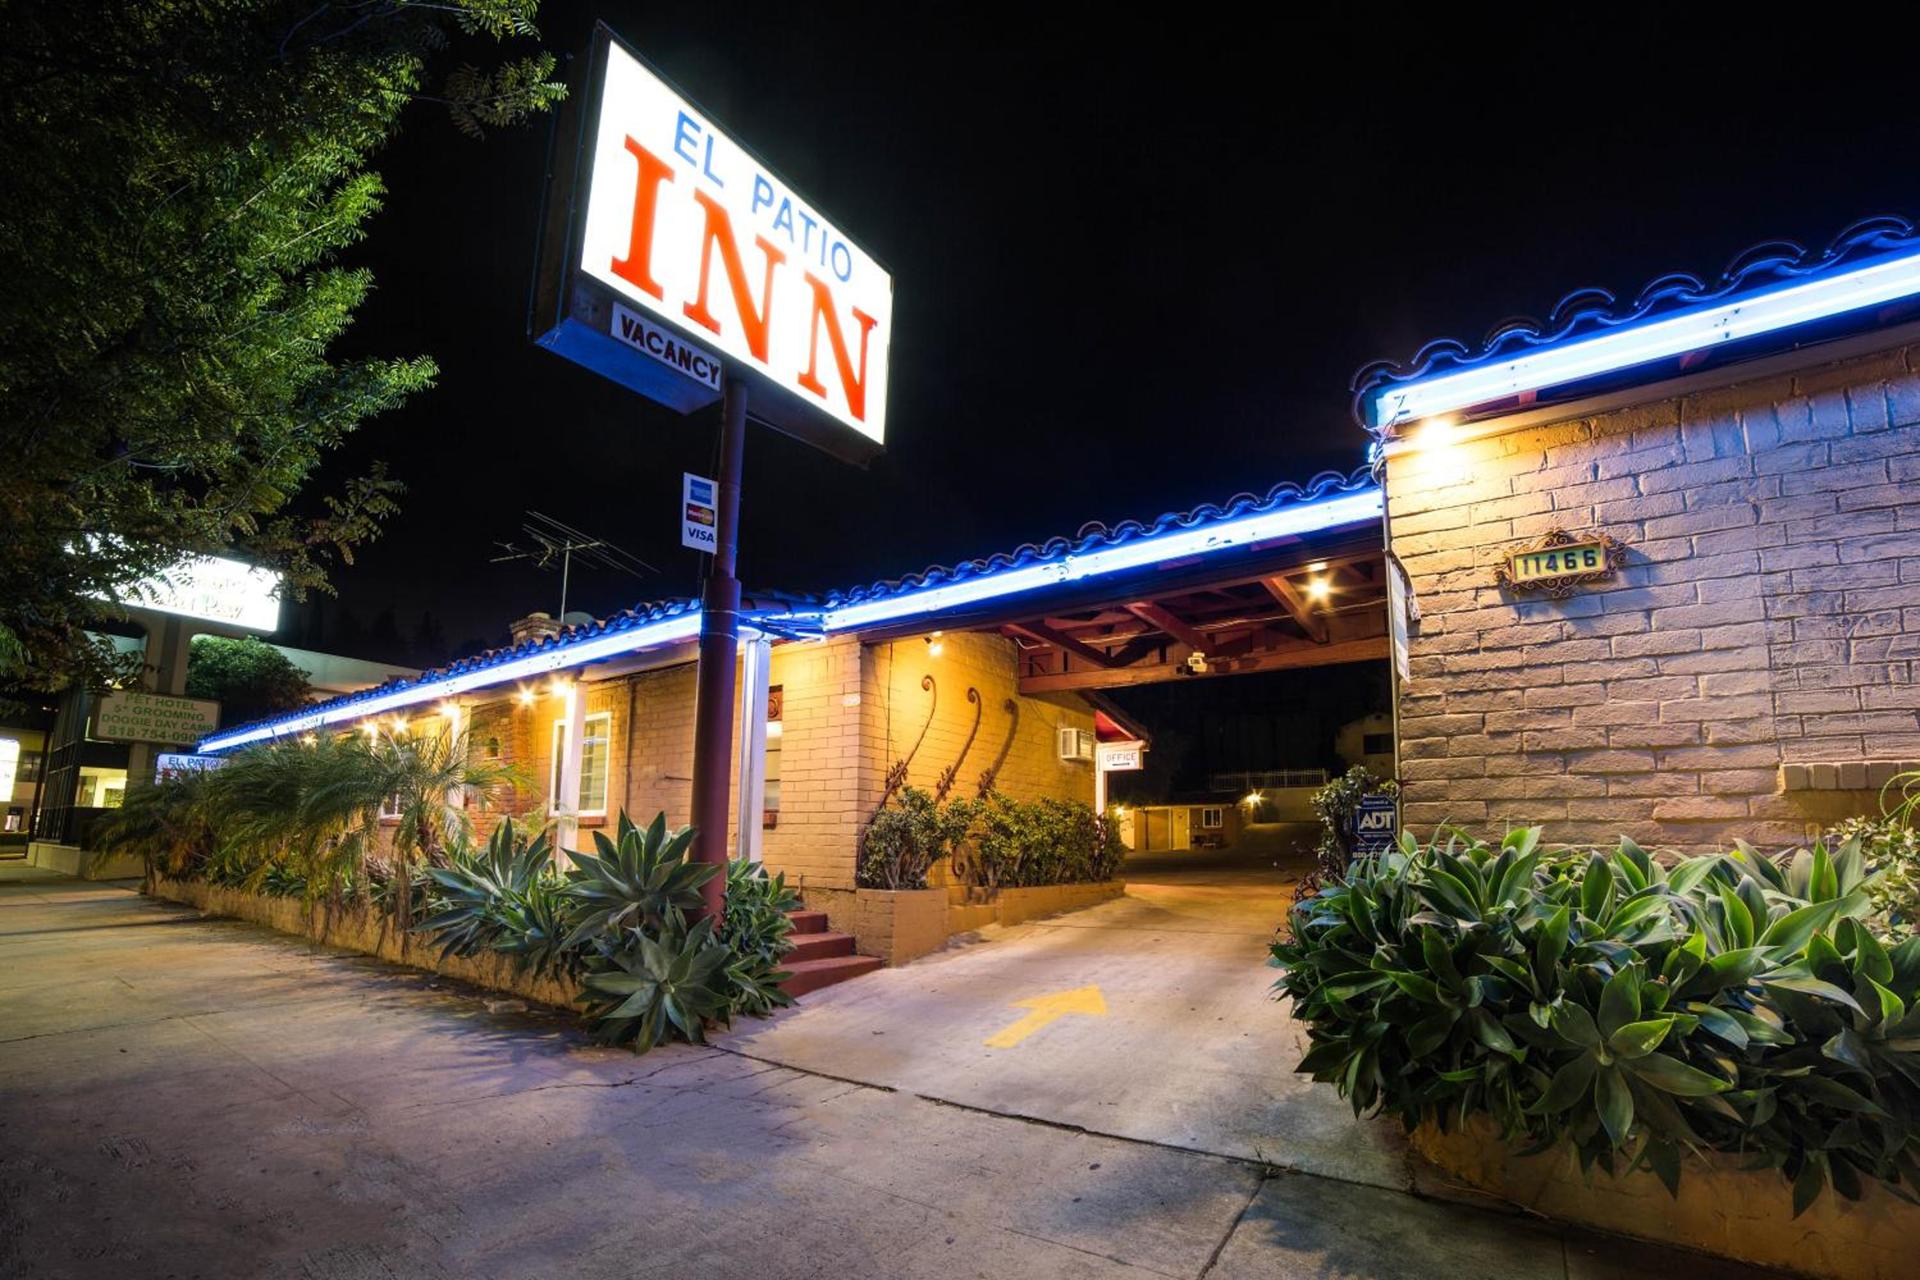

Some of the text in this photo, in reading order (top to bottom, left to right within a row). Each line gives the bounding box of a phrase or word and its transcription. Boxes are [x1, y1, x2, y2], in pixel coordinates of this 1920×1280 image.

[674, 110, 852, 283] EL PATIO
[610, 133, 878, 422] INN
[620, 314, 721, 385] VACANCY
[687, 527, 715, 543] VISA
[1522, 549, 1598, 574] 11466
[126, 693, 197, 711] PET HOTEL
[132, 706, 204, 721] GROOMING
[102, 714, 213, 732] DOGGIE DAY CAMP
[1106, 752, 1137, 762] OFFICE
[1360, 811, 1394, 829] ADT
